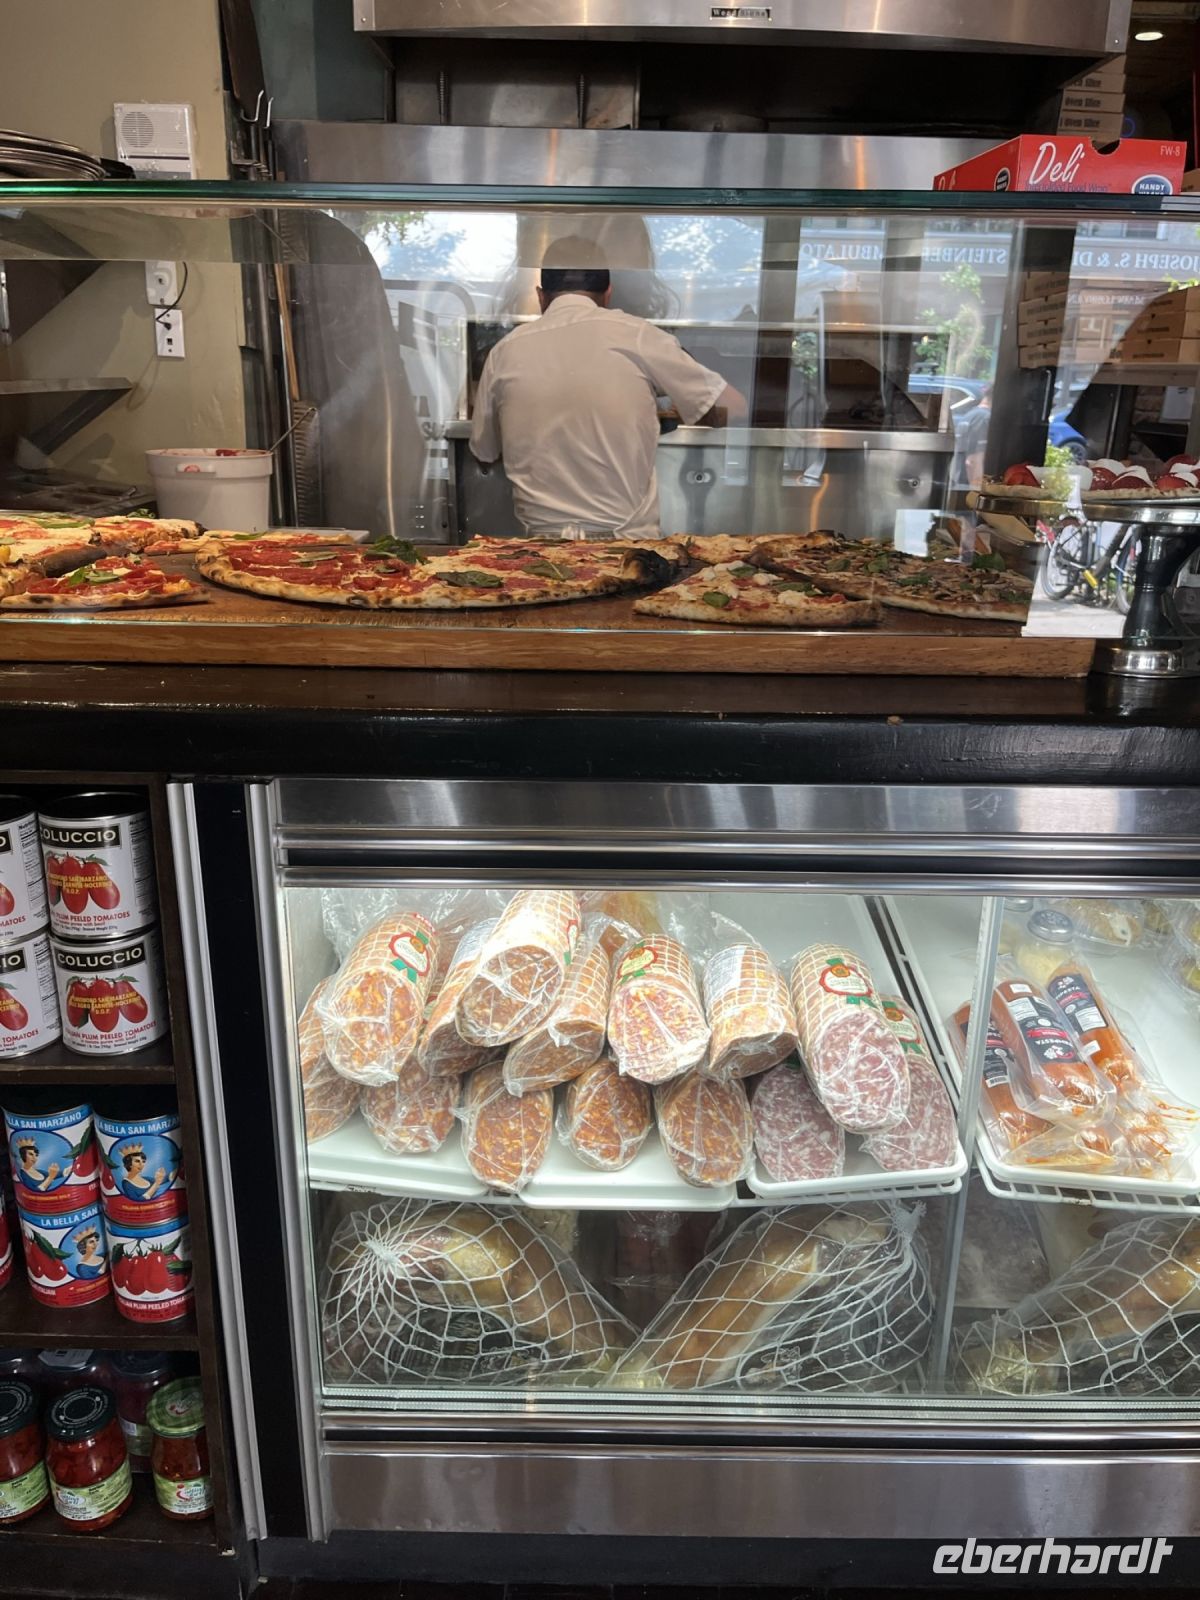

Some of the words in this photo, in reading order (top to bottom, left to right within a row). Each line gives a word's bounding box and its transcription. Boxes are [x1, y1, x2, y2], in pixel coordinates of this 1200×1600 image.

[1160, 145, 1180, 156] FW-8
[1028, 141, 1086, 184] Deli
[1140, 183, 1165, 191] HANDY
[94, 911, 130, 922] TOMATOES
[58, 948, 142, 967] COLUCCIO
[2, 1027, 39, 1044] TOMATOES
[100, 1032, 122, 1040] PEELED
[20, 1120, 36, 1128] SAN
[39, 1111, 82, 1128] MARZANO
[104, 1123, 126, 1134] BELLA
[128, 1126, 146, 1134] SAN
[41, 1218, 52, 1226] LA
[53, 1216, 80, 1226] BELLA
[81, 1207, 98, 1220] SAN
[148, 1302, 170, 1310] PEELED
